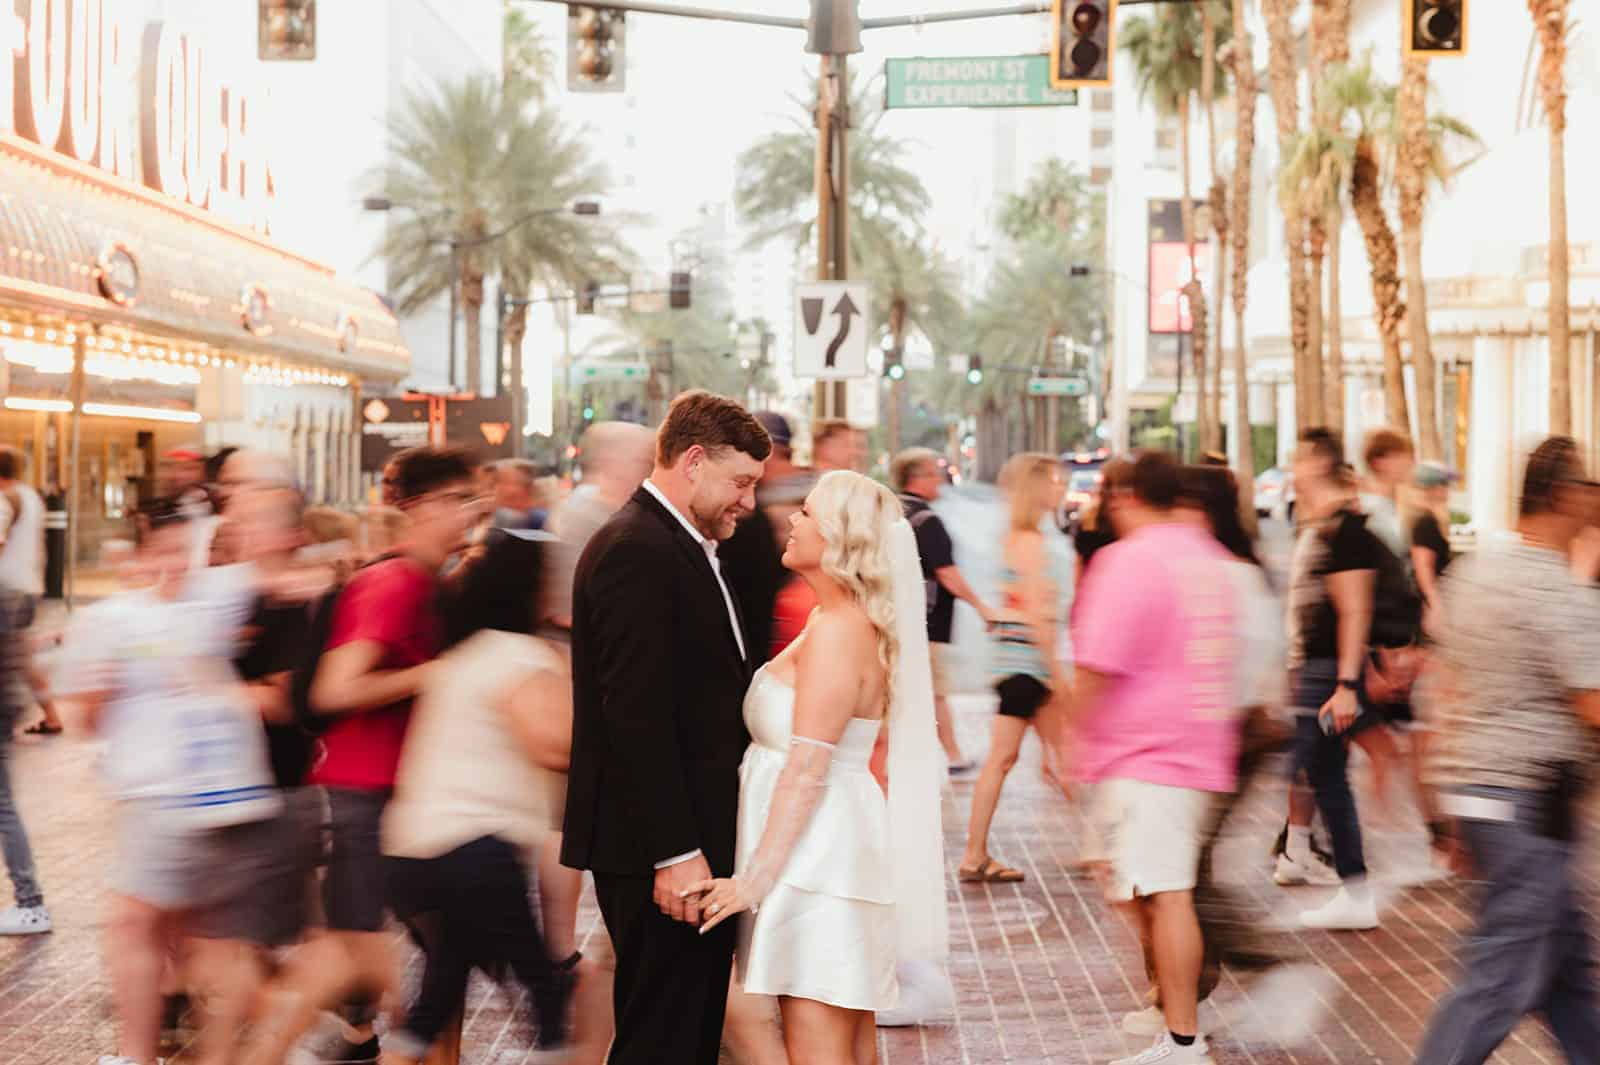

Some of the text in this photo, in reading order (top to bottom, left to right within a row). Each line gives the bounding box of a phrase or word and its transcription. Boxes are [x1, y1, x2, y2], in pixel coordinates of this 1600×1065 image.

[904, 60, 1025, 81] FREMONT ST
[904, 84, 1031, 104] EXPERIENCE
